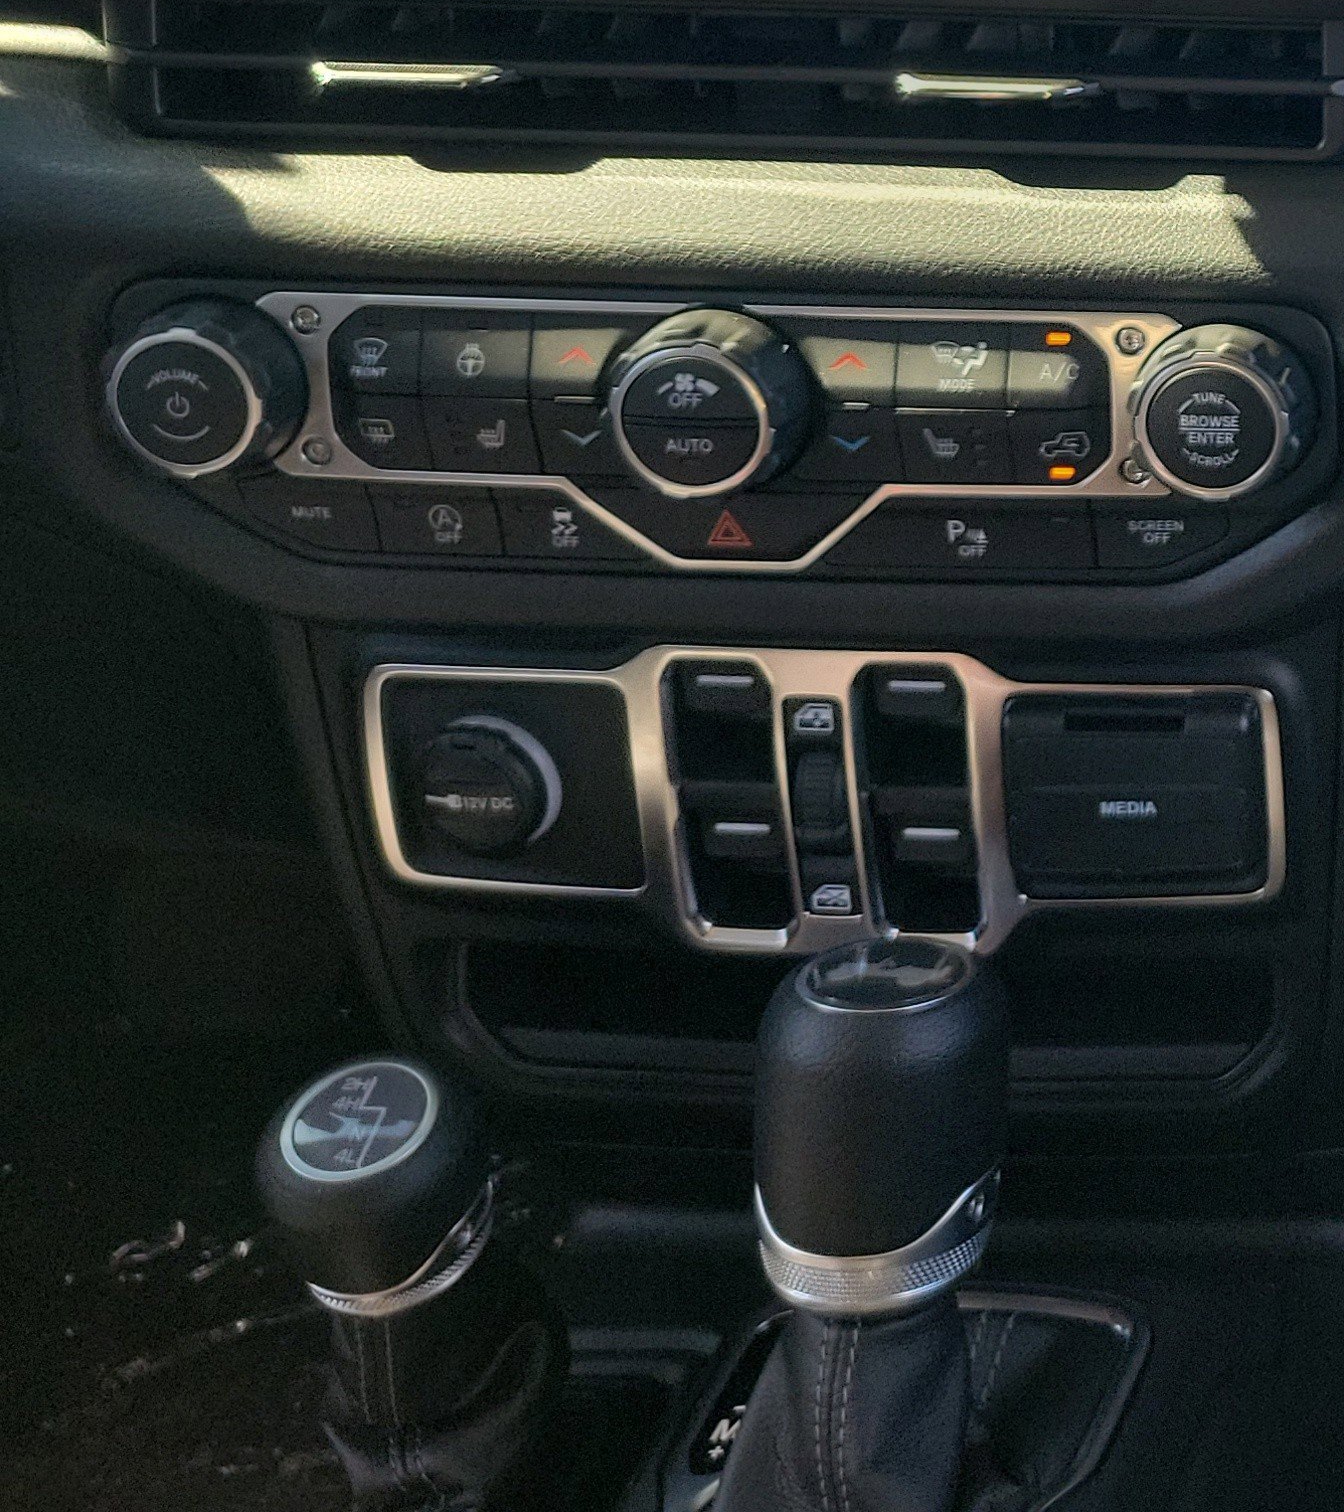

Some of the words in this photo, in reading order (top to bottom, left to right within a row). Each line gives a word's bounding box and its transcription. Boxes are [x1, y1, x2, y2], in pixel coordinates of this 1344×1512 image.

[1040, 362, 1080, 381] A/C
[939, 378, 975, 390] MODE
[668, 392, 702, 408] OFF
[1193, 391, 1227, 405] TUNE
[1180, 415, 1240, 428] BROWSE
[1187, 432, 1236, 445] ENTER
[665, 438, 714, 454] AUTO
[291, 506, 331, 519] MUTE
[946, 519, 966, 545] P
[1126, 519, 1184, 532] SCREEN
[551, 534, 580, 548] OFF
[1142, 532, 1171, 546] OFF
[462, 796, 489, 809] 12V
[491, 796, 514, 809] DC
[1099, 800, 1159, 815] MEDIA
[709, 1418, 741, 1443] M
